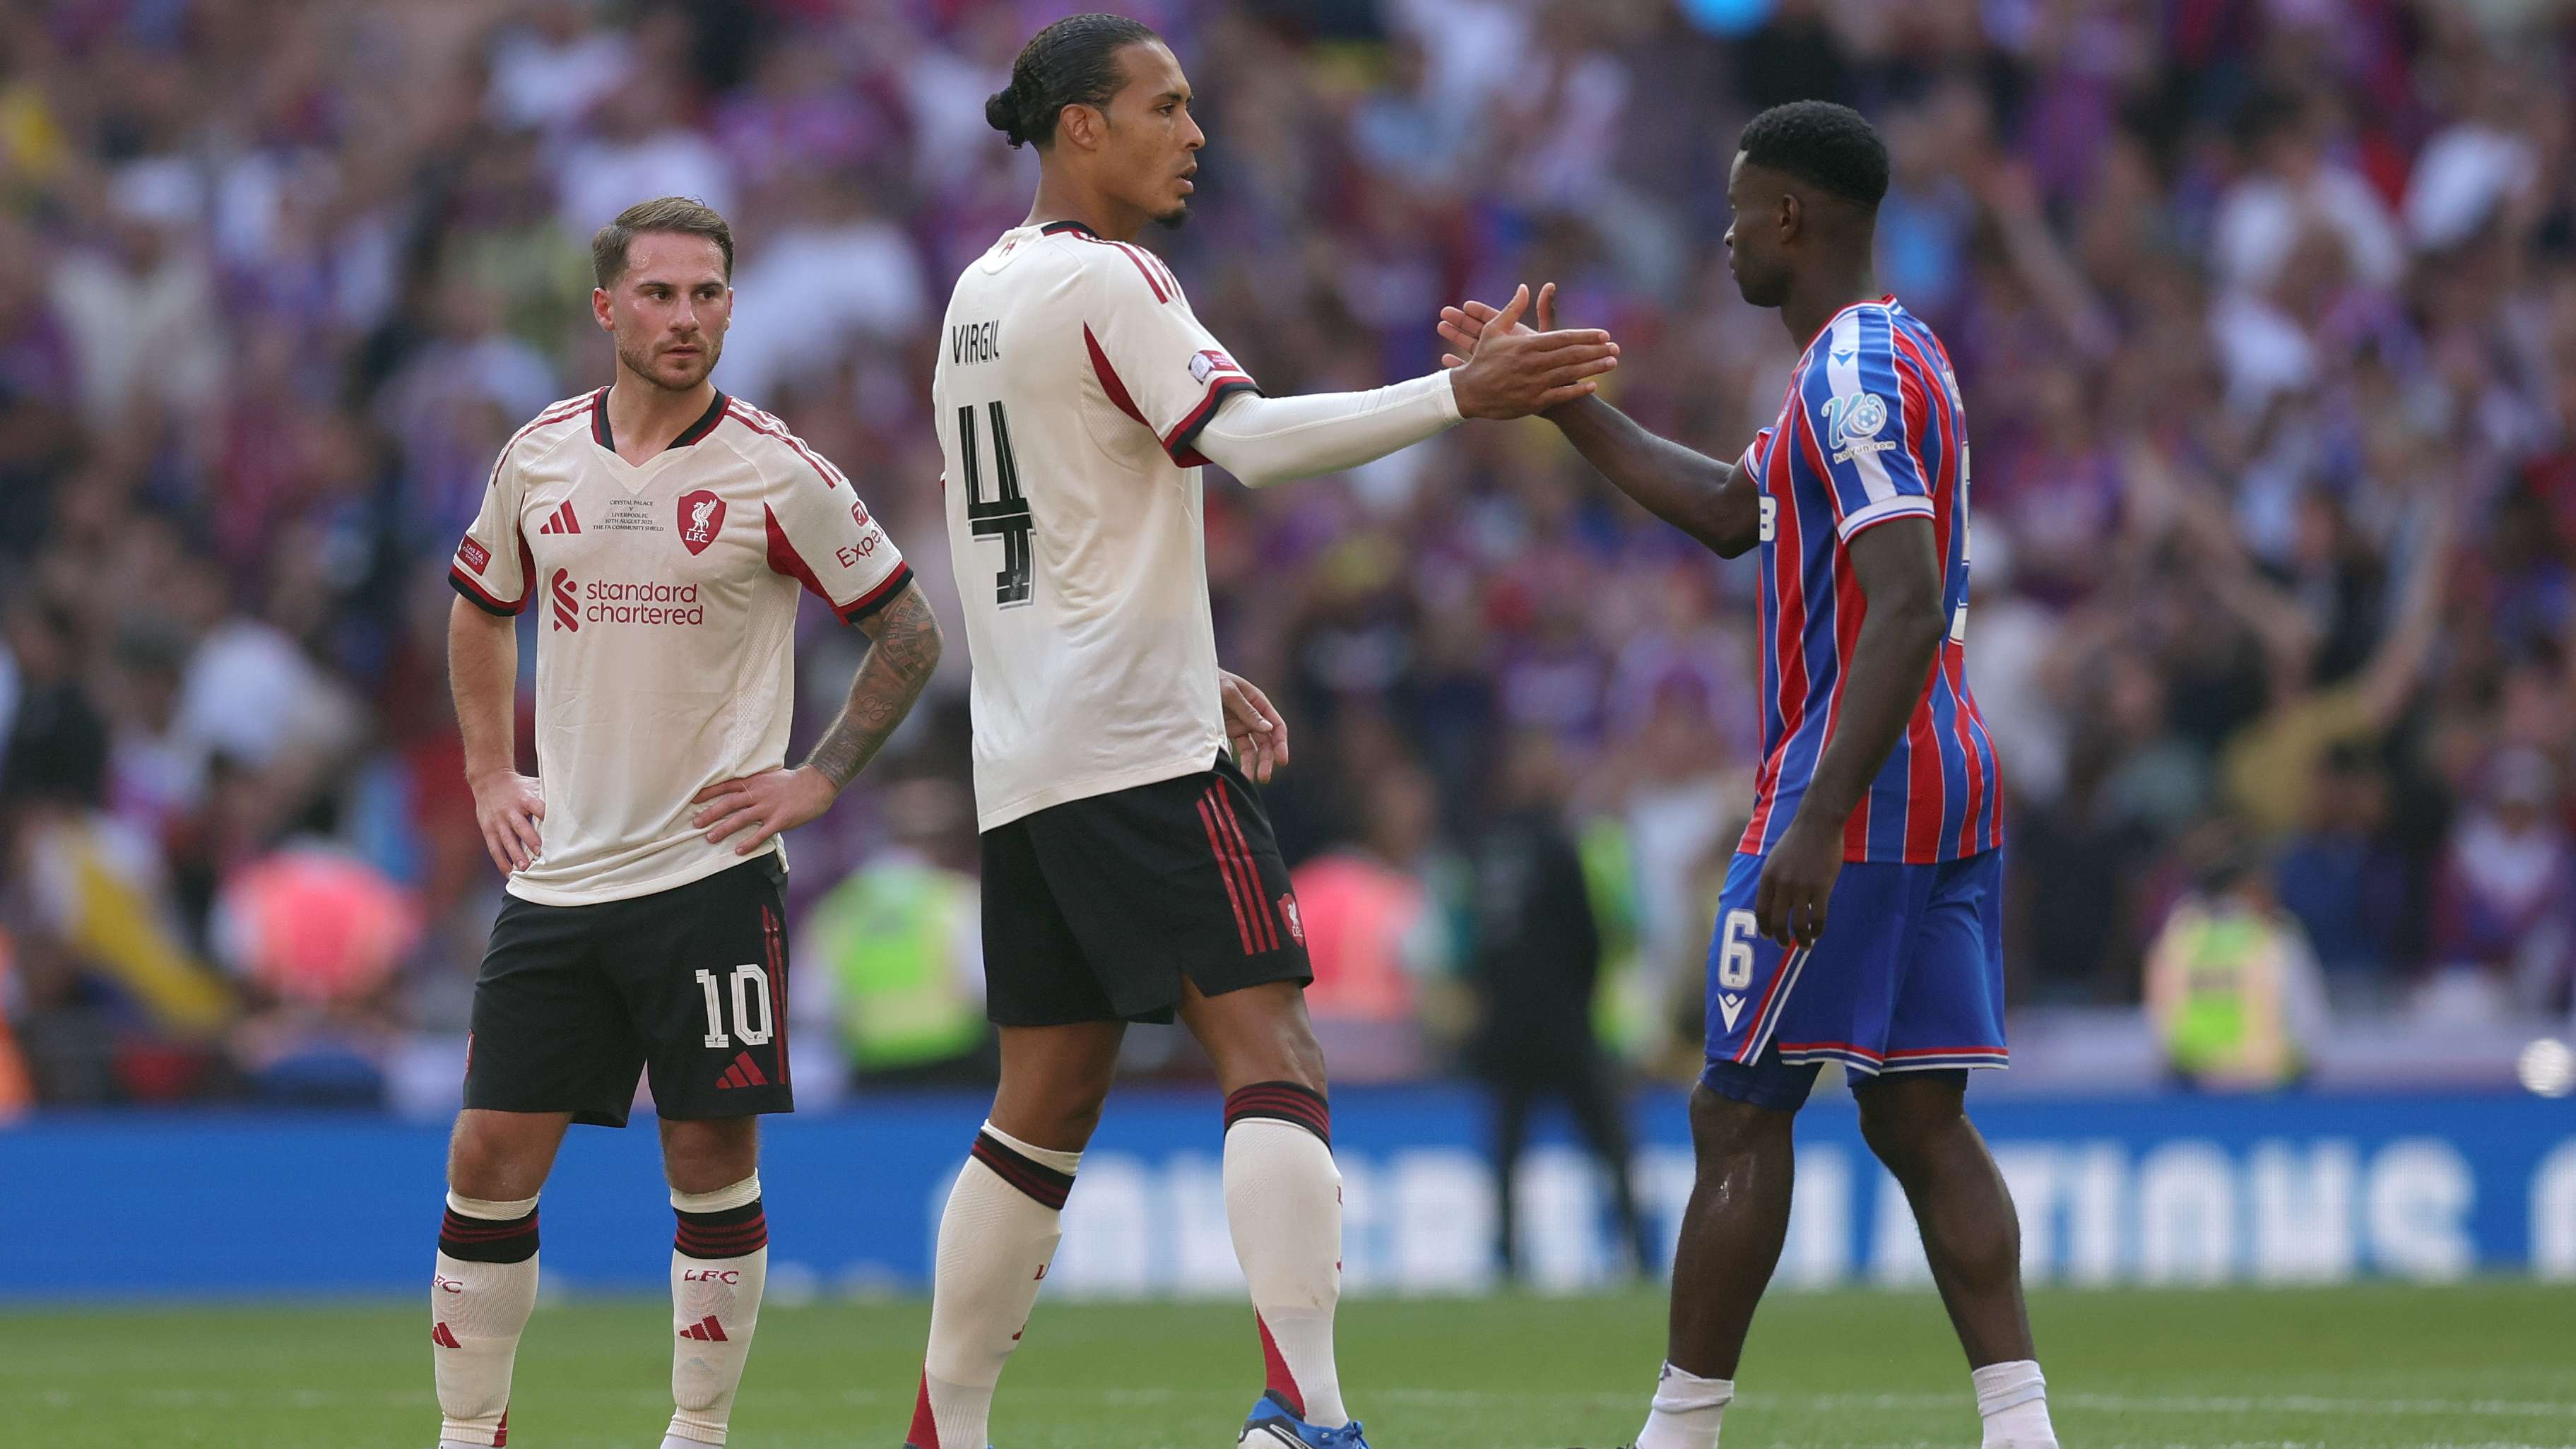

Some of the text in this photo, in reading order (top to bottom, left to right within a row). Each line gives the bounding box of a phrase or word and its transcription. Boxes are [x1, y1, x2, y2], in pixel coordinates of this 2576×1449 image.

[952, 319, 1000, 365] VIRGIL
[958, 400, 1036, 608] 4
[586, 579, 698, 603] standard
[586, 601, 704, 625] chartered
[1718, 908, 1758, 990] 6
[695, 963, 774, 1048] 10
[432, 1274, 463, 1294] FC
[684, 1269, 739, 1285] LFC
